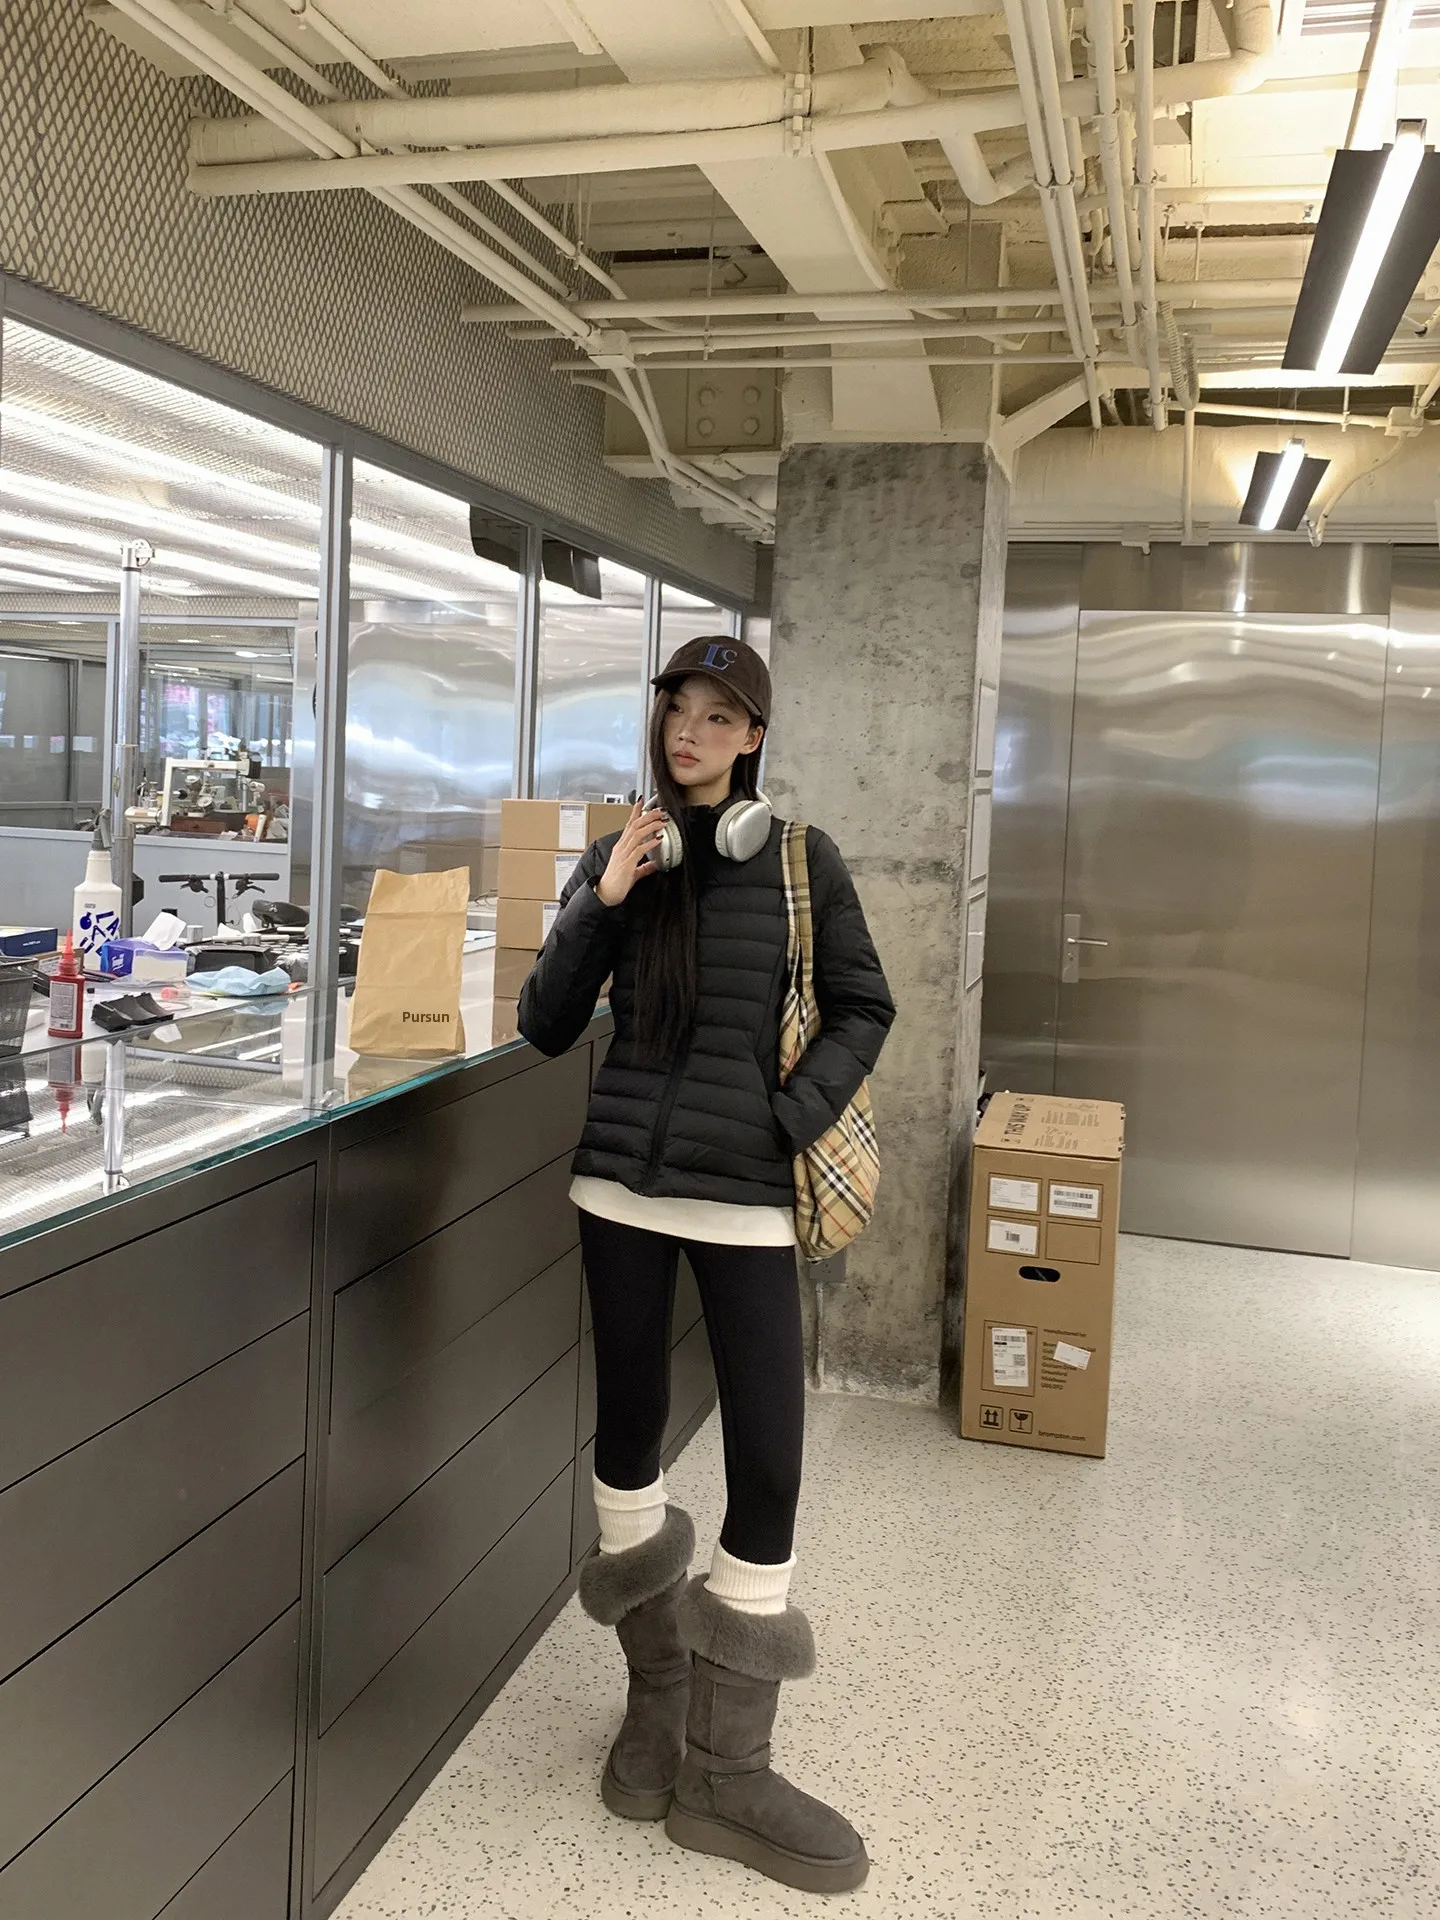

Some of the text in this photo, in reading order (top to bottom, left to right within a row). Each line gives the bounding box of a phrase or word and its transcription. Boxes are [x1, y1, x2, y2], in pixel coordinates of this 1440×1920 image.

[402, 1011, 450, 1023] Pursun
[1004, 1103, 1031, 1136] THIS WAY UP
[1038, 1430, 1086, 1442] brompton.com
